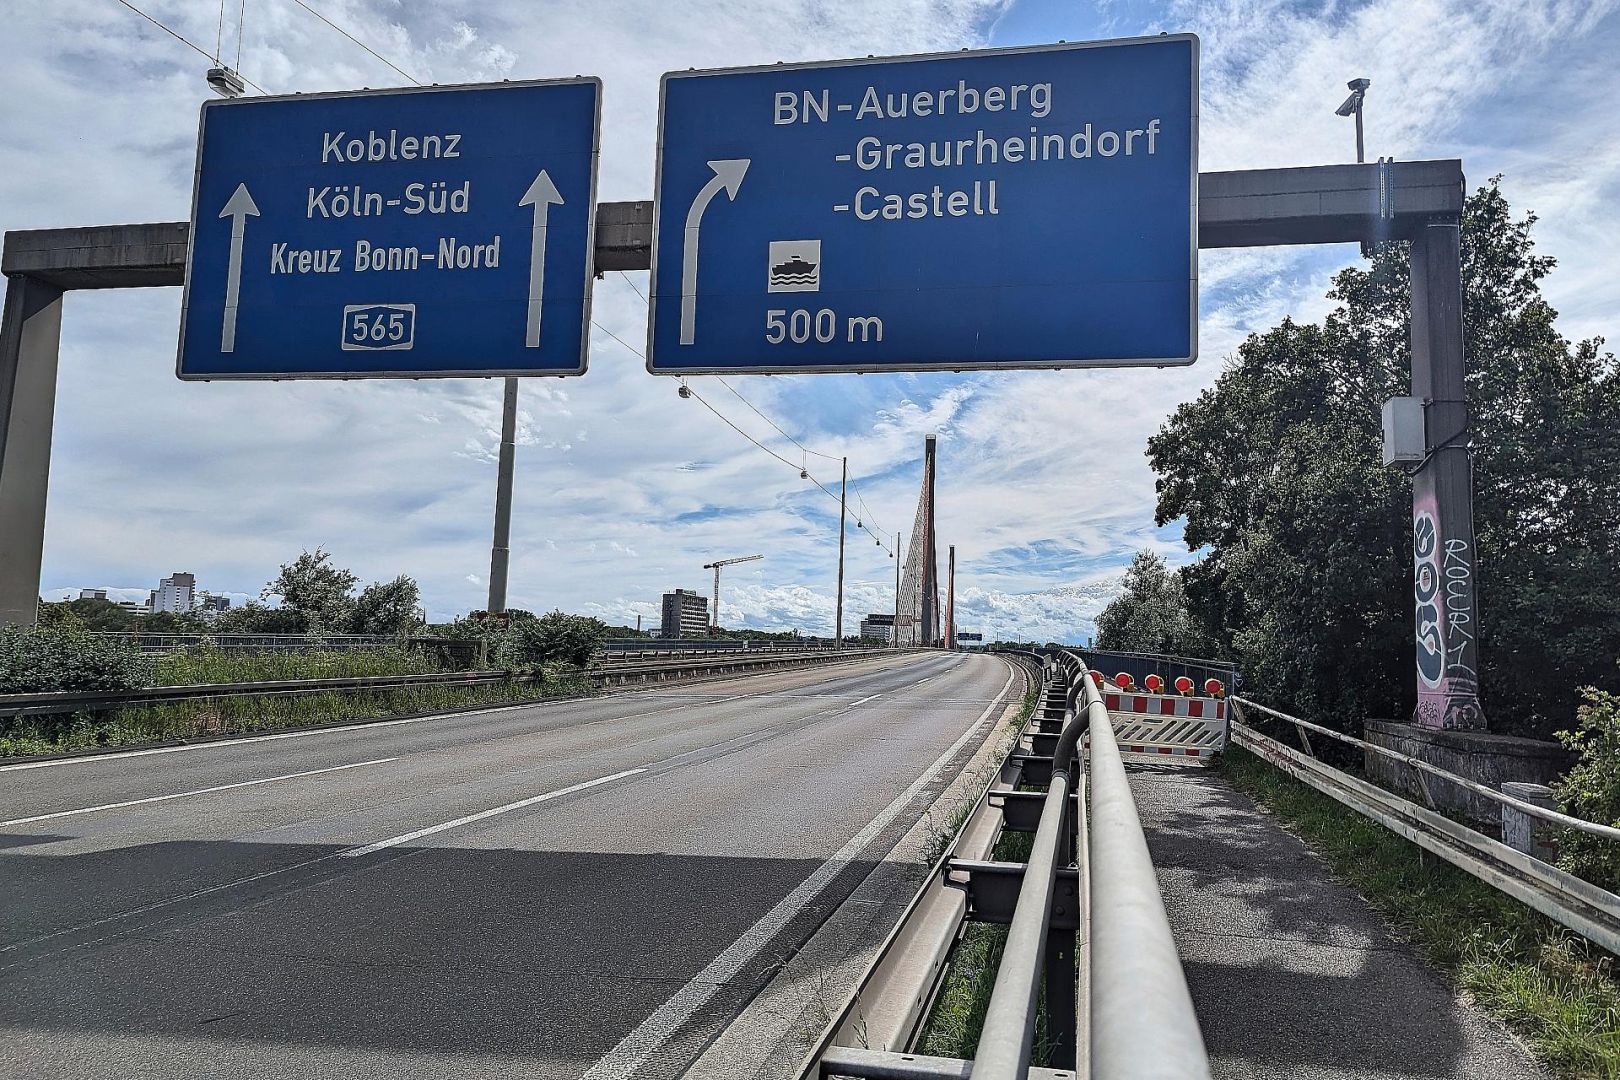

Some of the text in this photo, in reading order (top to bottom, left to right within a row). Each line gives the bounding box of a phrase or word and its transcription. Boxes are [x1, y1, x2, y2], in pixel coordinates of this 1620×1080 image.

[322, 129, 462, 163] Koblenz
[835, 118, 1161, 171] -Graurheindorf
[306, 180, 470, 219] Köln-Süd
[833, 180, 999, 221] -Castell
[270, 235, 501, 274] Kreuz Bonn-Nord
[352, 313, 404, 341] 565
[765, 308, 883, 344] 500 m
